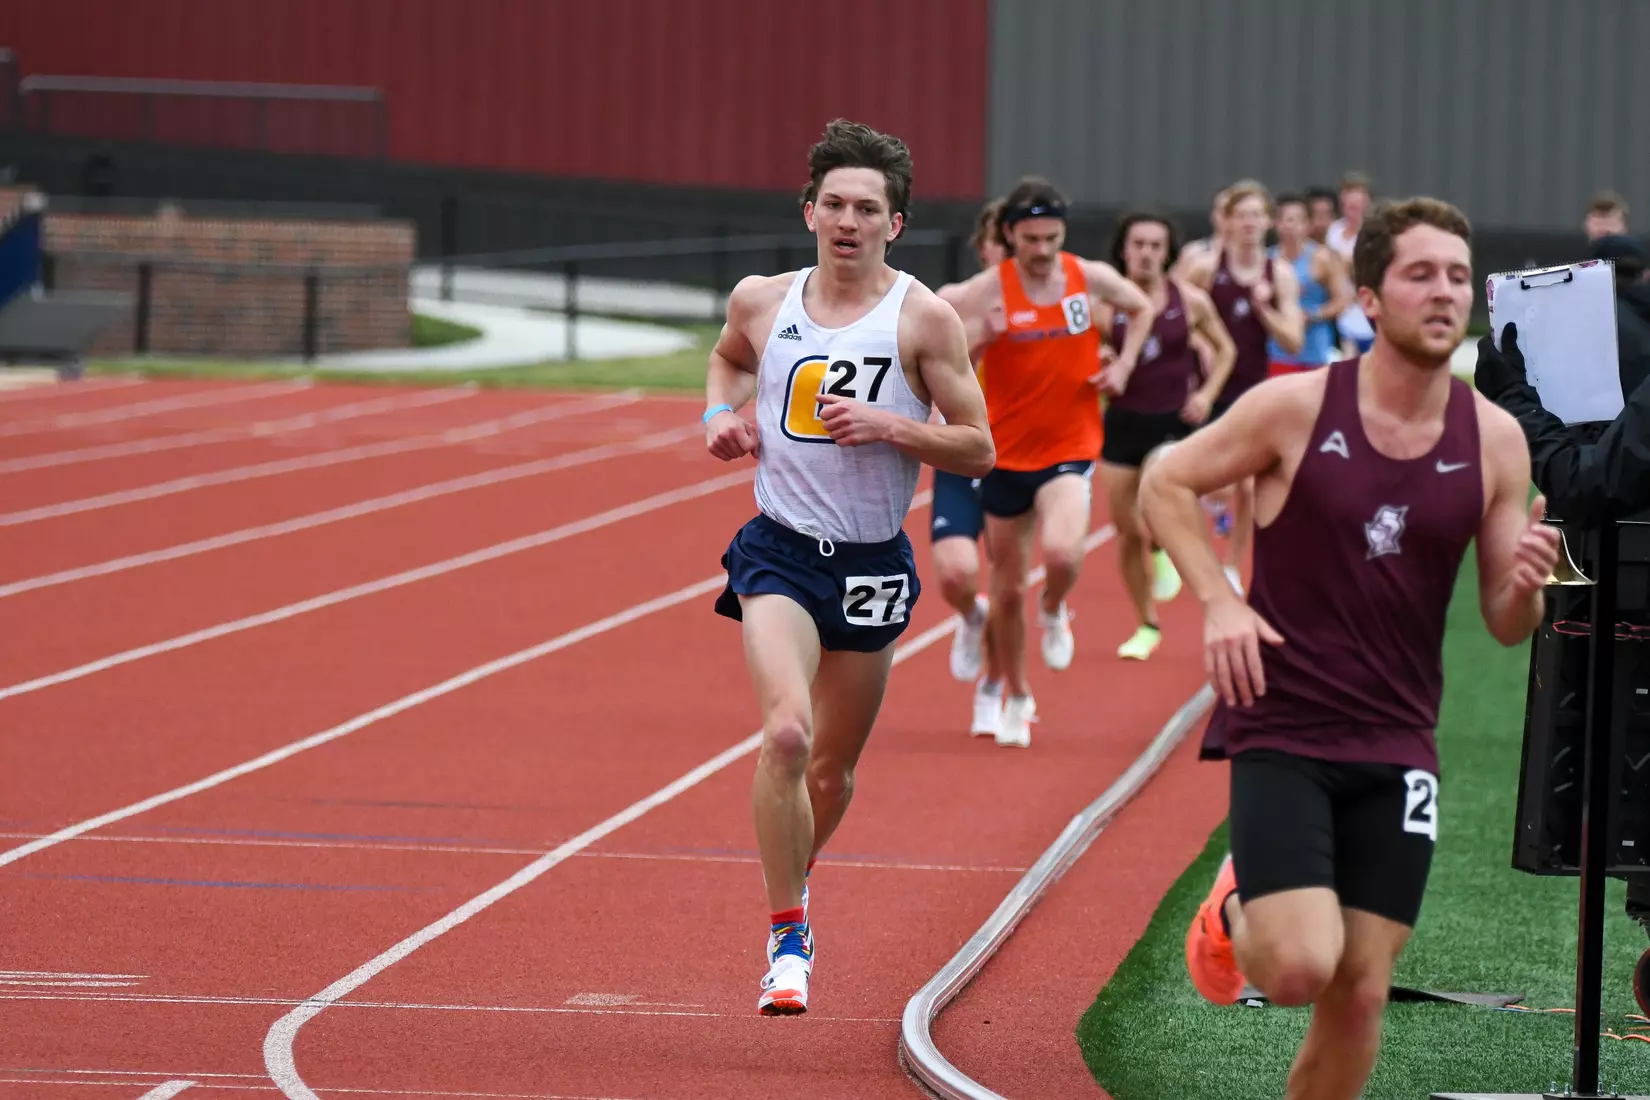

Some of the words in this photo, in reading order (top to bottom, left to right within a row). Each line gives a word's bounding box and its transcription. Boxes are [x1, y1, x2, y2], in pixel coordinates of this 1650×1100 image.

[1070, 300, 1084, 328] 8
[778, 333, 802, 341] adidas
[827, 357, 892, 402] 27
[846, 579, 904, 622] 27
[1408, 778, 1432, 823] 2
